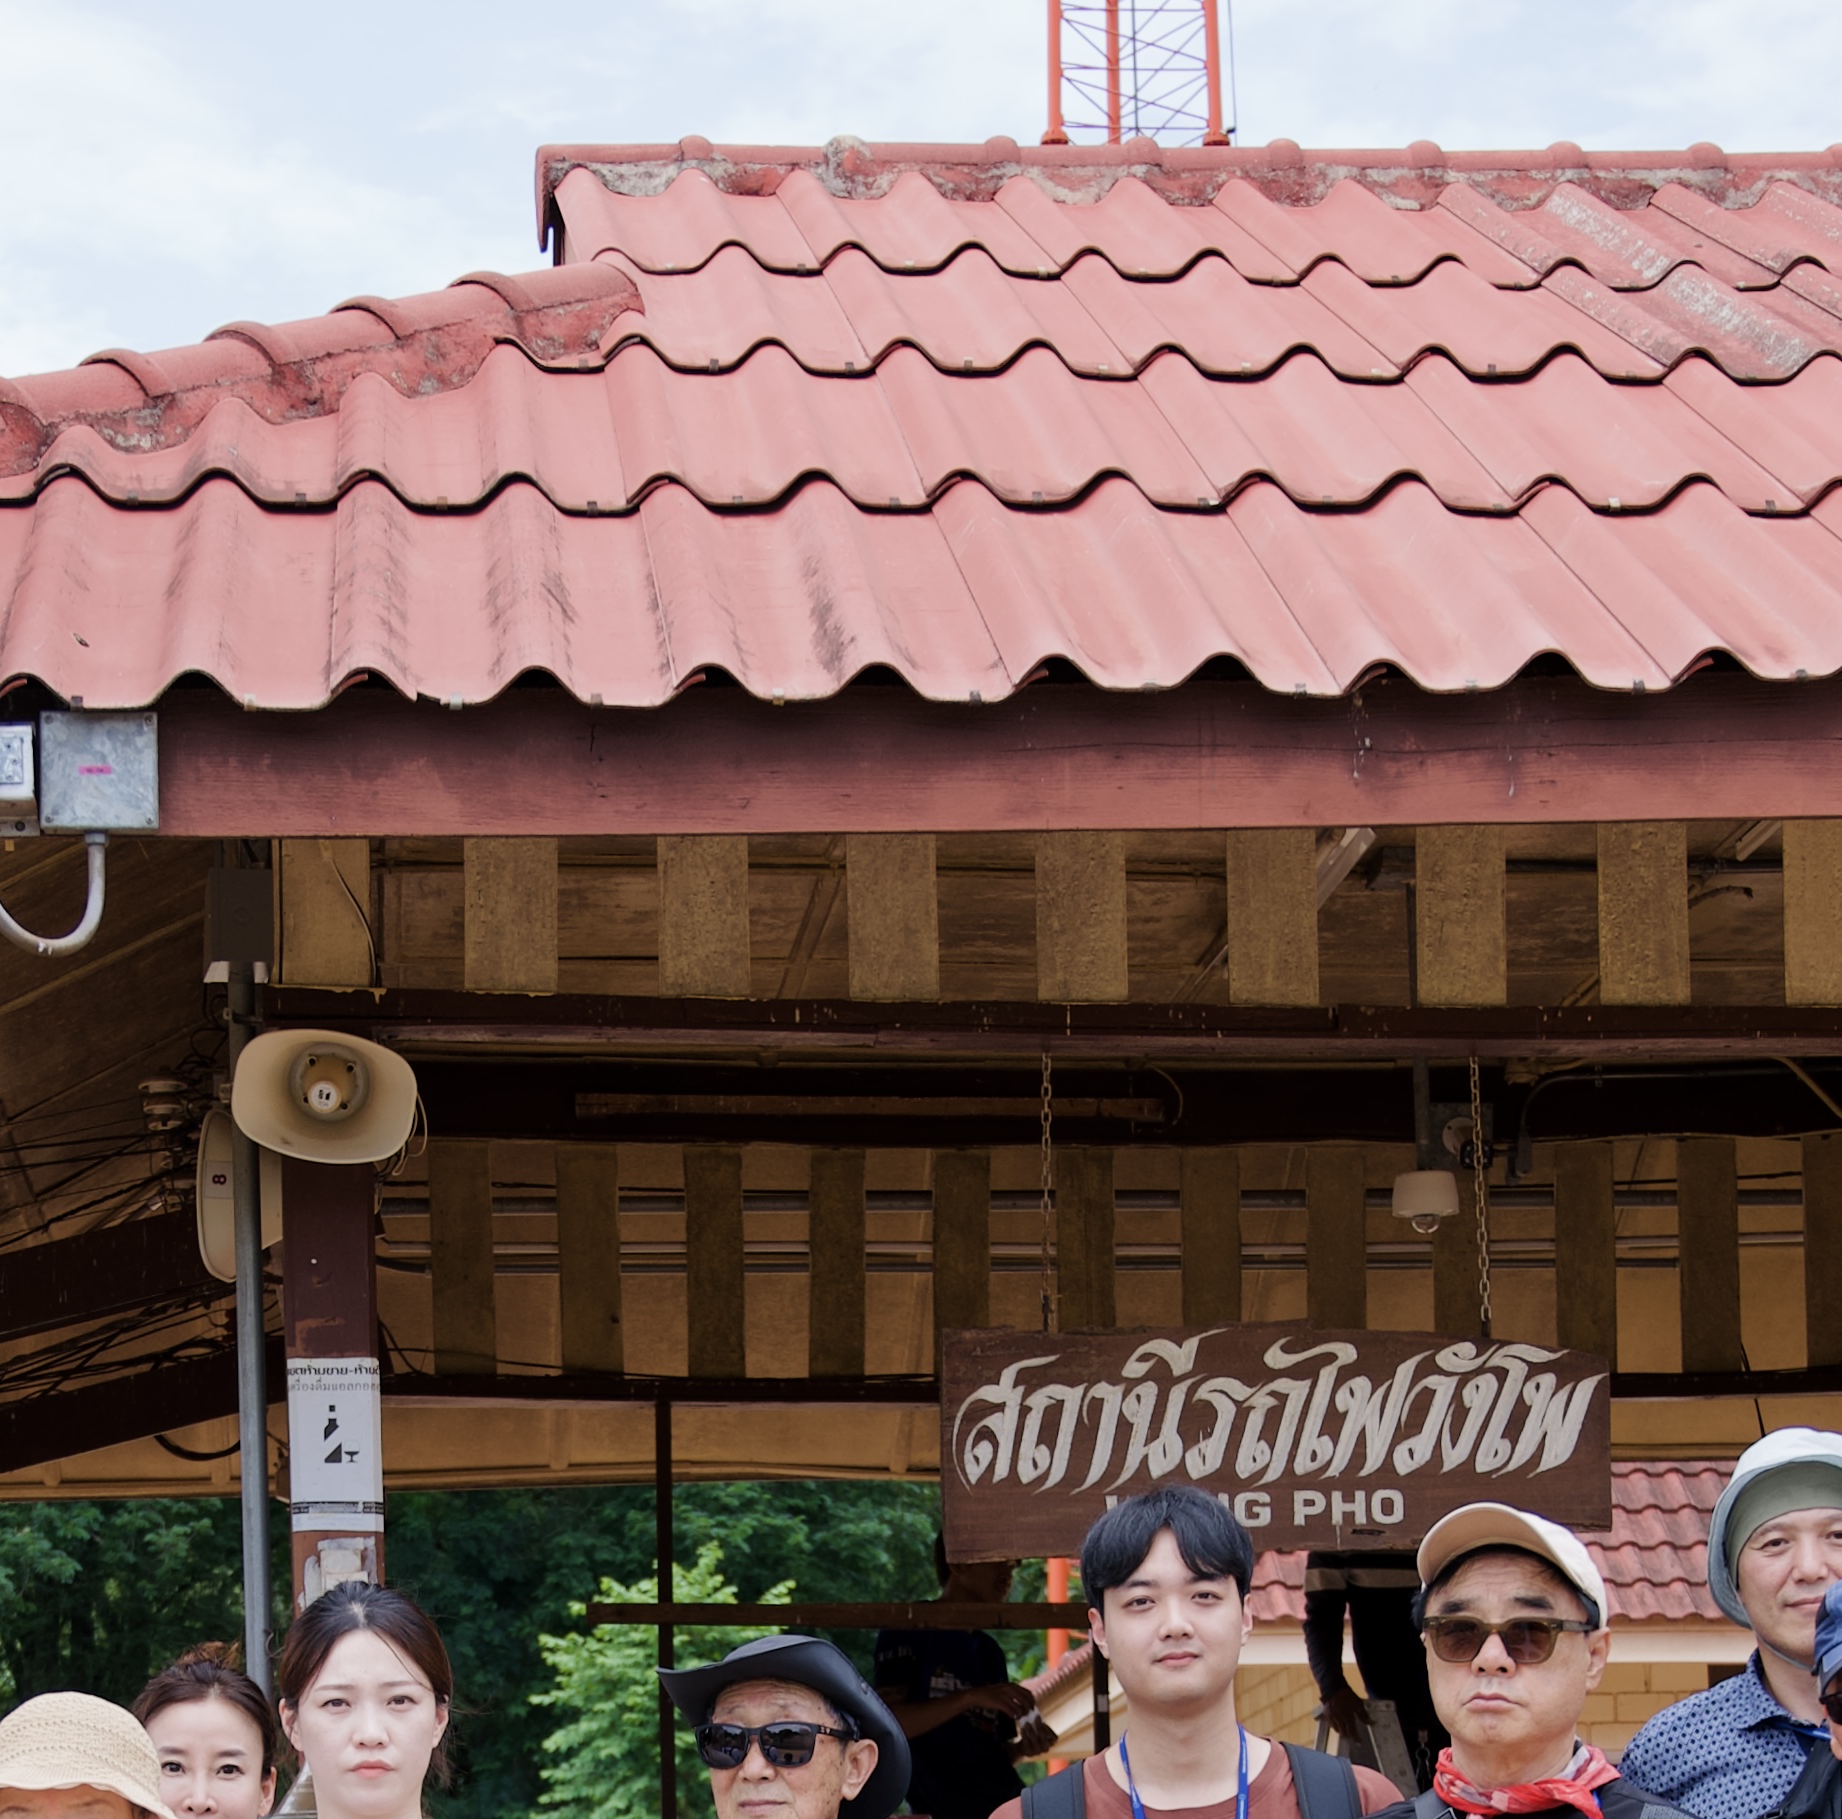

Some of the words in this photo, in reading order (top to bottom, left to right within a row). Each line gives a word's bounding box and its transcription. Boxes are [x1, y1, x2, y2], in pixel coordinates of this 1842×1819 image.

[212, 1174, 227, 1186] 8
[951, 1328, 1609, 1496] สถานีรถไฟวังโพ
[1293, 1488, 1406, 1527] PHO
